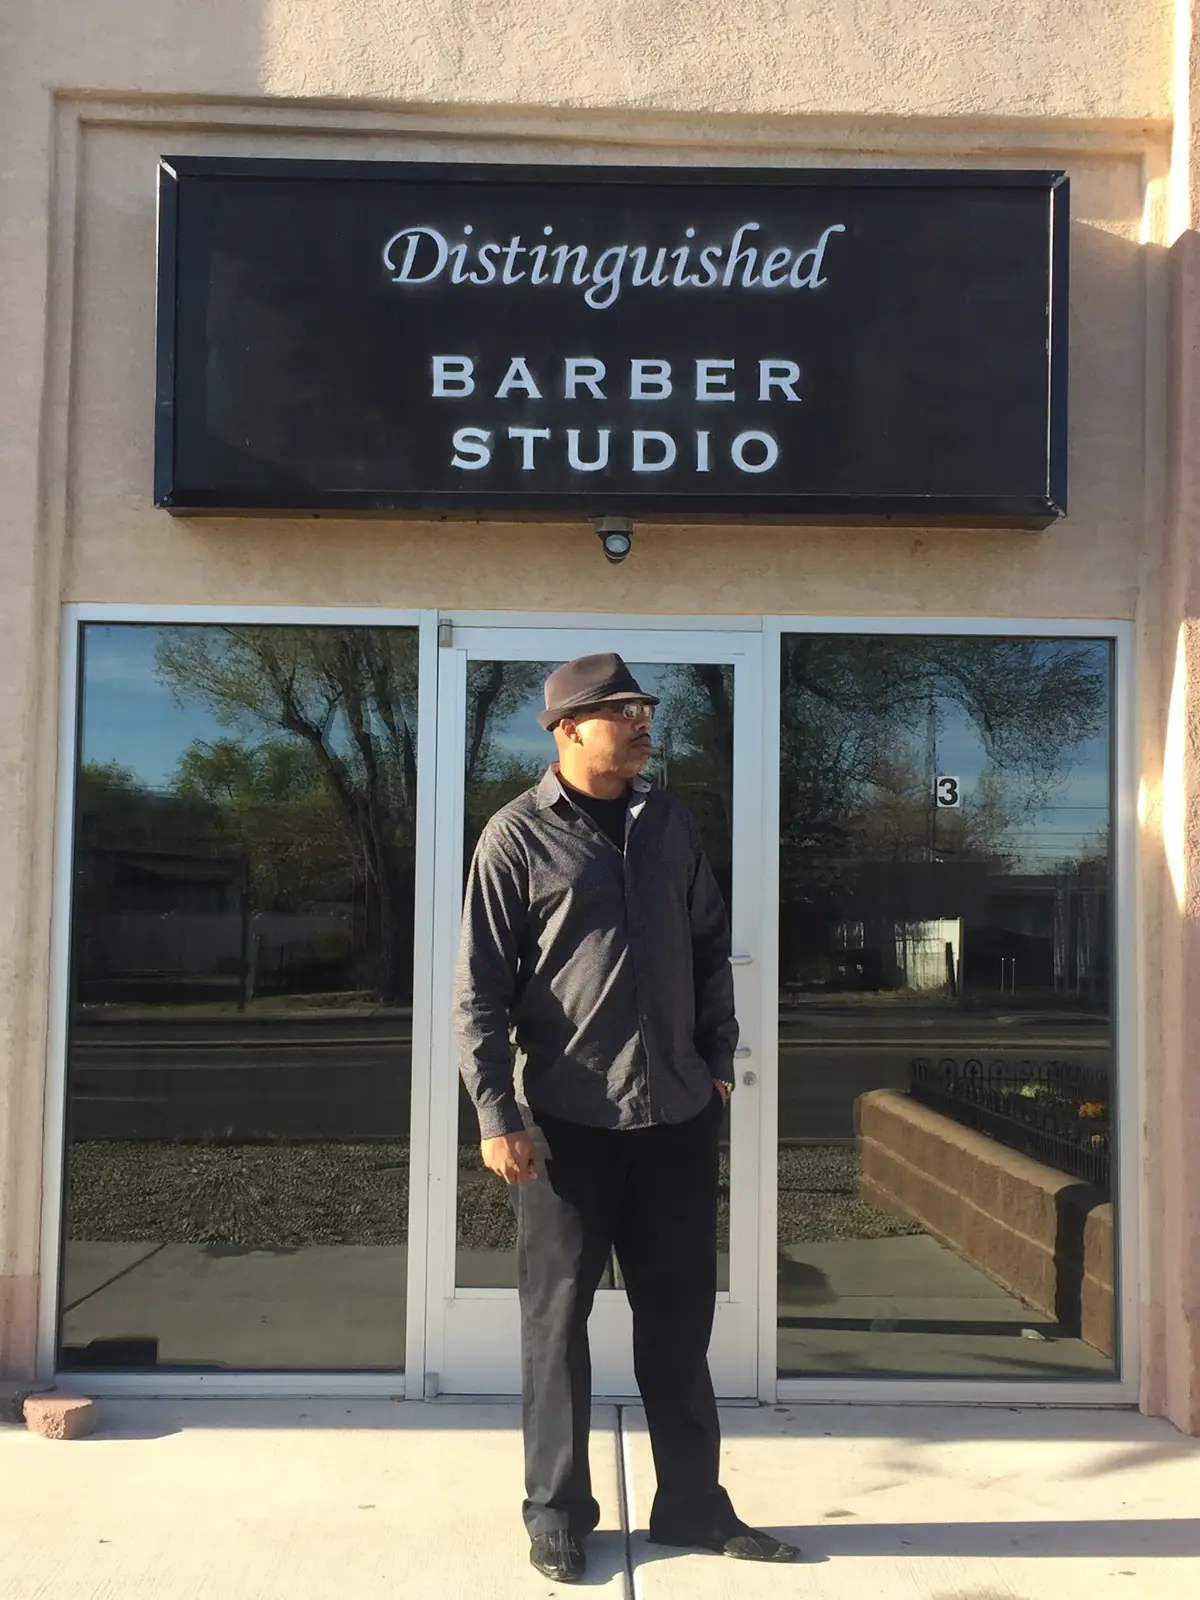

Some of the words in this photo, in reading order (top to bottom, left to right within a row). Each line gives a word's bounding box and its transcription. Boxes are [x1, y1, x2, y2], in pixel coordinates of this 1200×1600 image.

[382, 222, 846, 310] Distinguished
[431, 355, 802, 402] BARBER
[450, 426, 779, 474] STUDIO
[938, 778, 959, 806] 3
